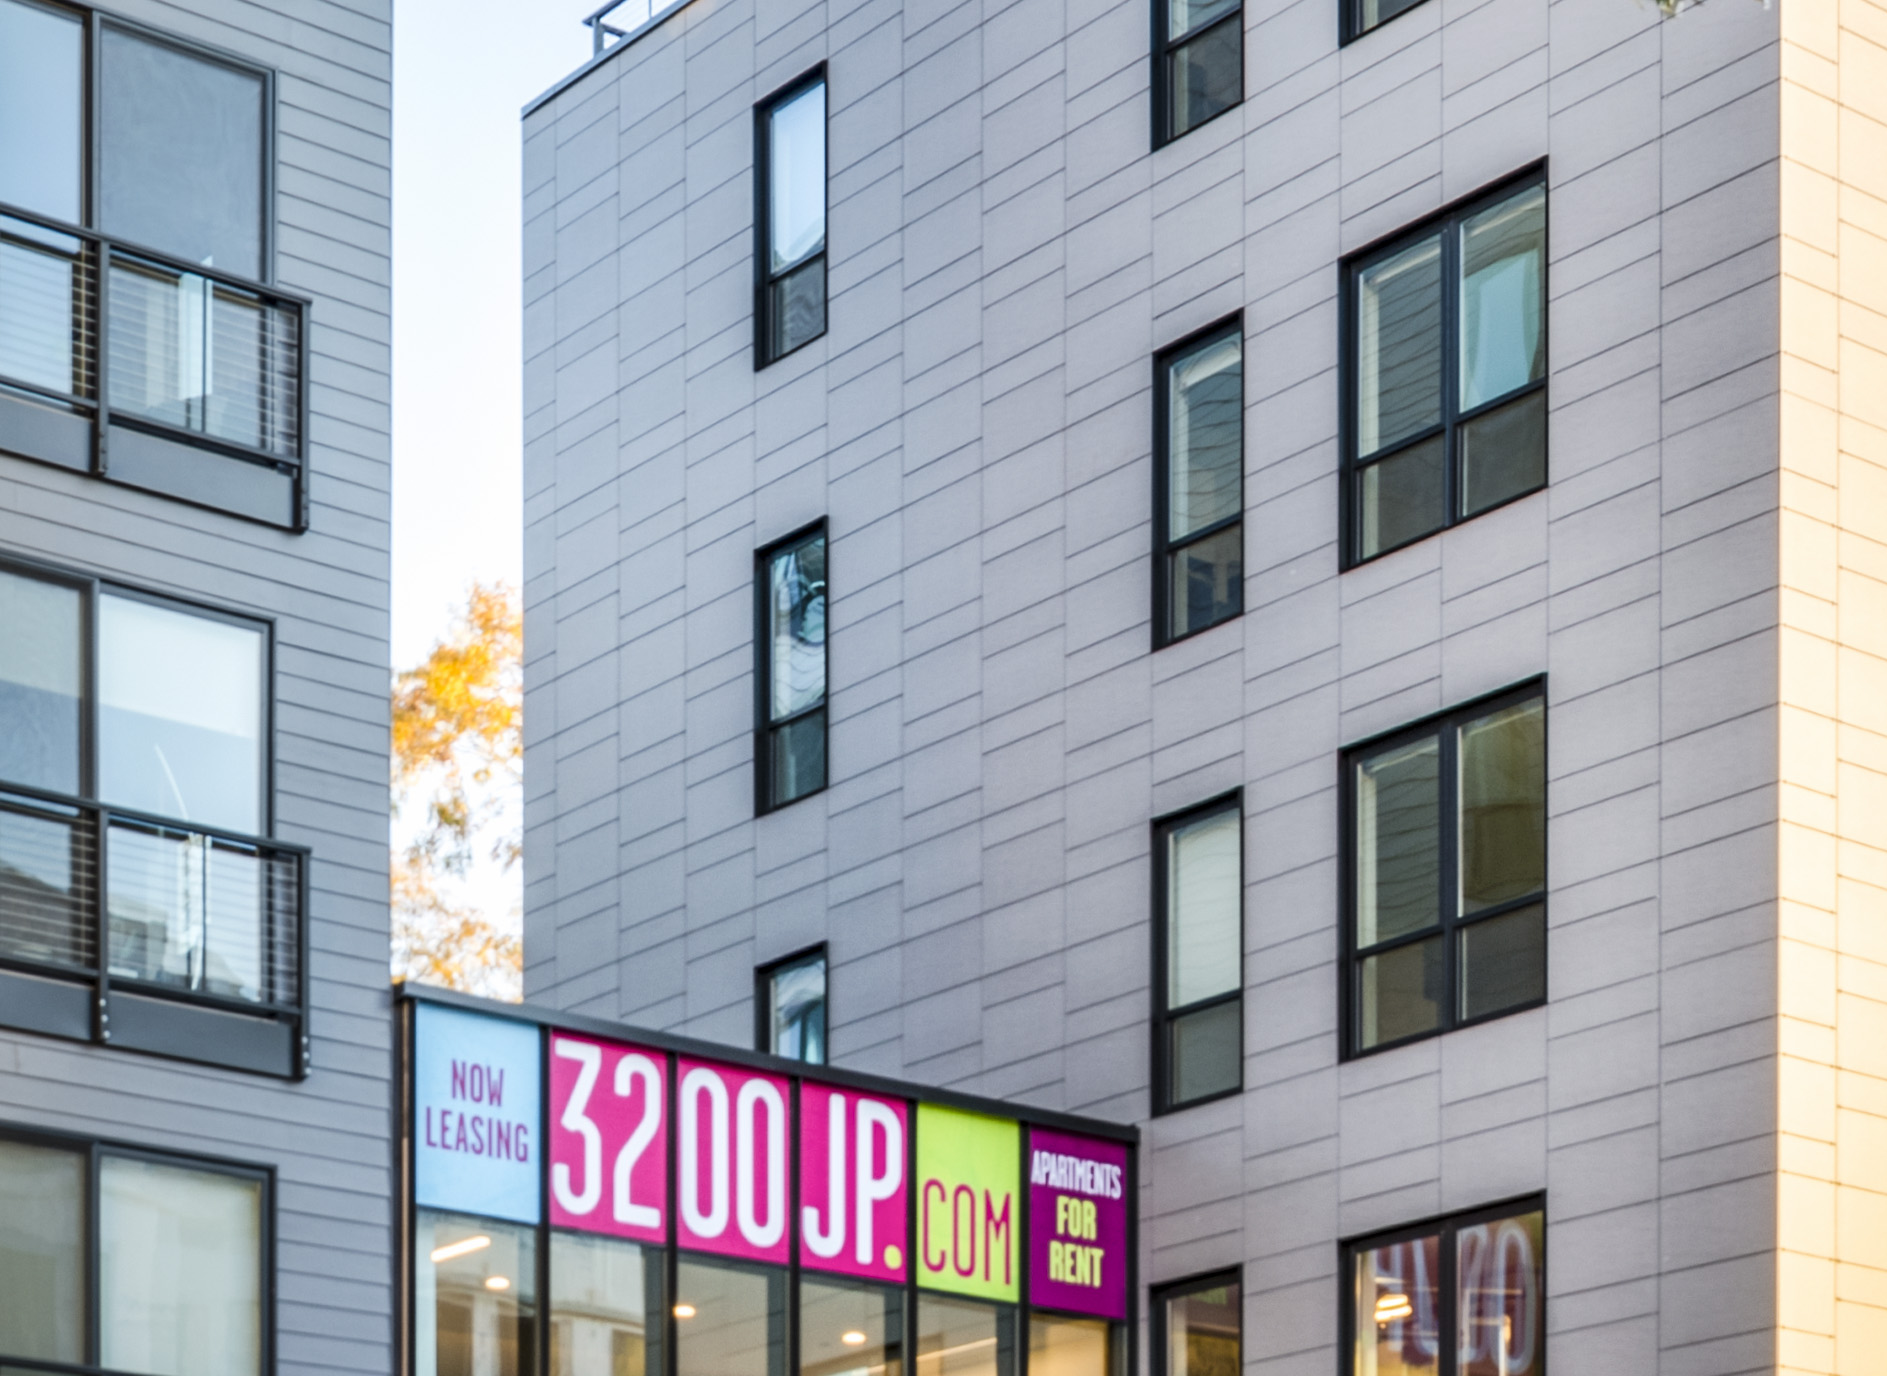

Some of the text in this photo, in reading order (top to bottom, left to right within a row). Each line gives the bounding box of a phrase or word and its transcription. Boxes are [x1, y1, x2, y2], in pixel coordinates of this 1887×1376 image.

[451, 1059, 503, 1106] NOW
[425, 1107, 528, 1161] LEASING
[1031, 1150, 1122, 1200] APARTMENTS
[1057, 1195, 1097, 1241] FOR
[1049, 1240, 1104, 1288] RENT
